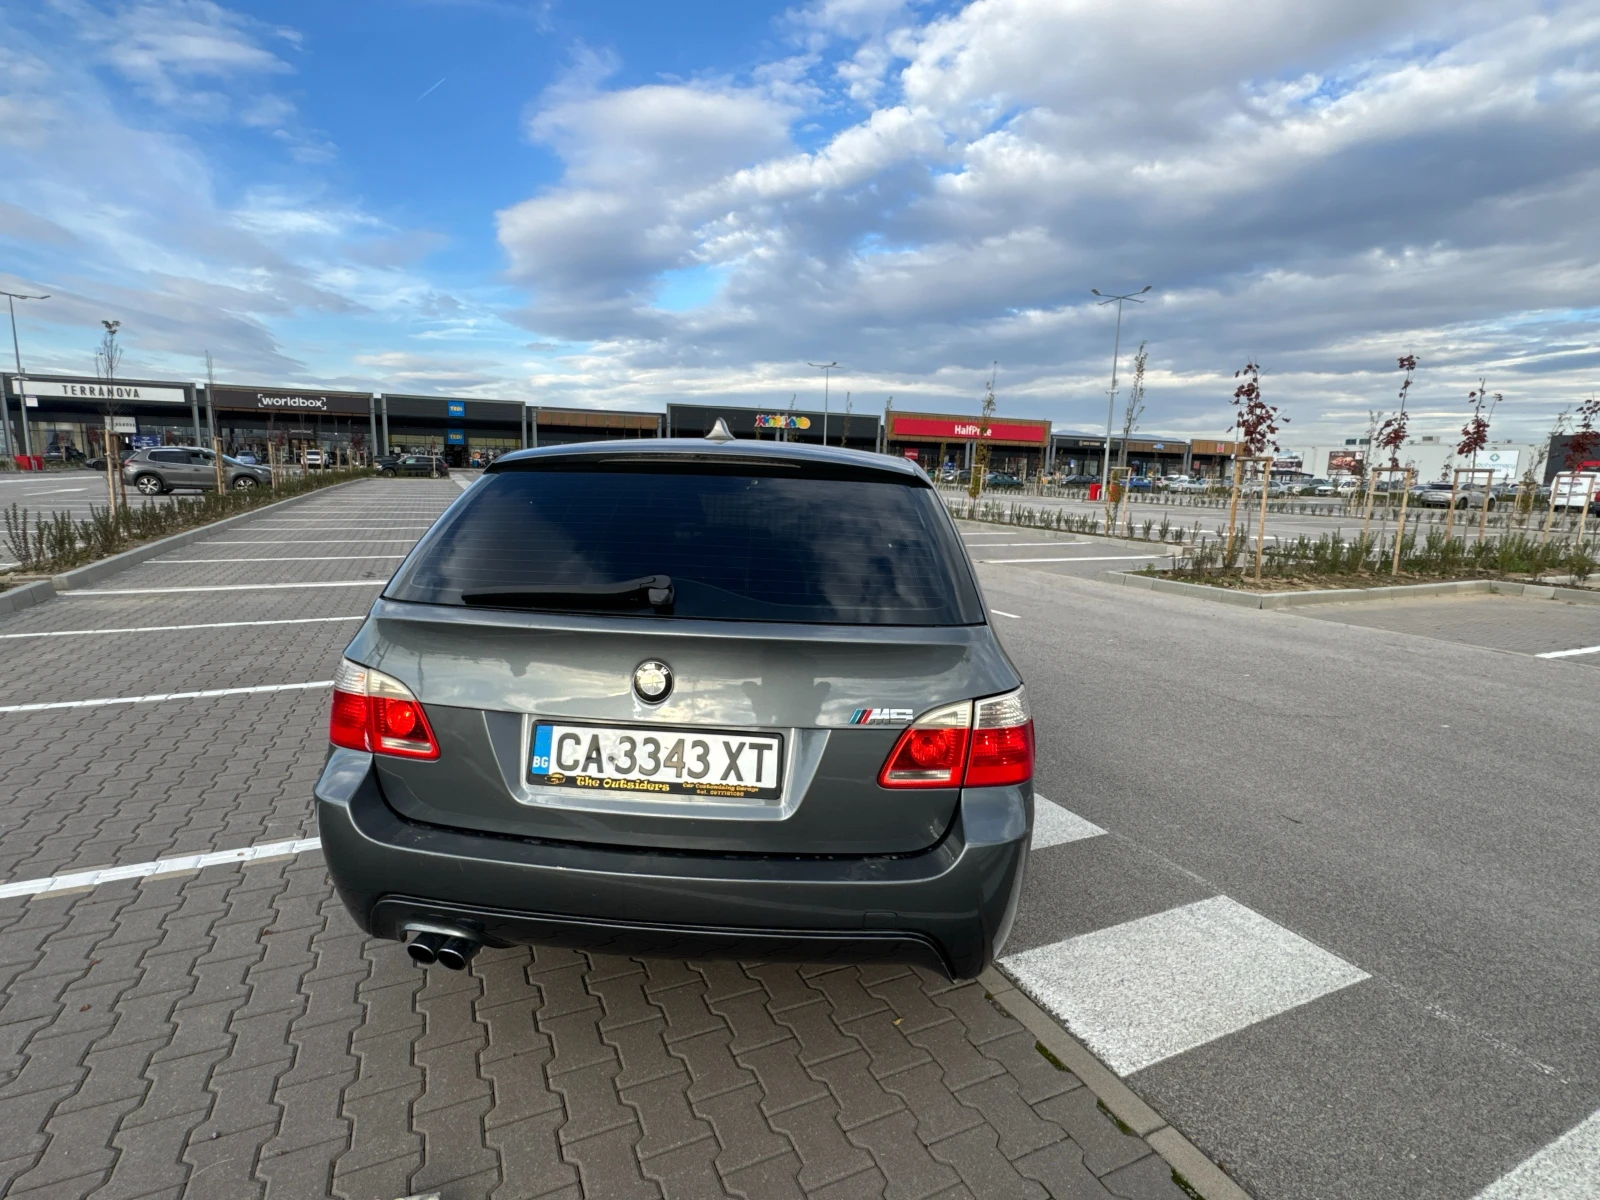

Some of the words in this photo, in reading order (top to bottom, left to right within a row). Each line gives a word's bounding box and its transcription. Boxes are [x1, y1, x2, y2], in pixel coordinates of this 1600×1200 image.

[62, 384, 141, 399] TERRANOVA
[261, 396, 323, 408] worldbox
[532, 756, 549, 769] BG
[556, 733, 605, 774] CA
[614, 736, 710, 779] 3343
[721, 741, 773, 783] XT
[576, 775, 600, 787] The
[603, 778, 670, 791] Outsiders
